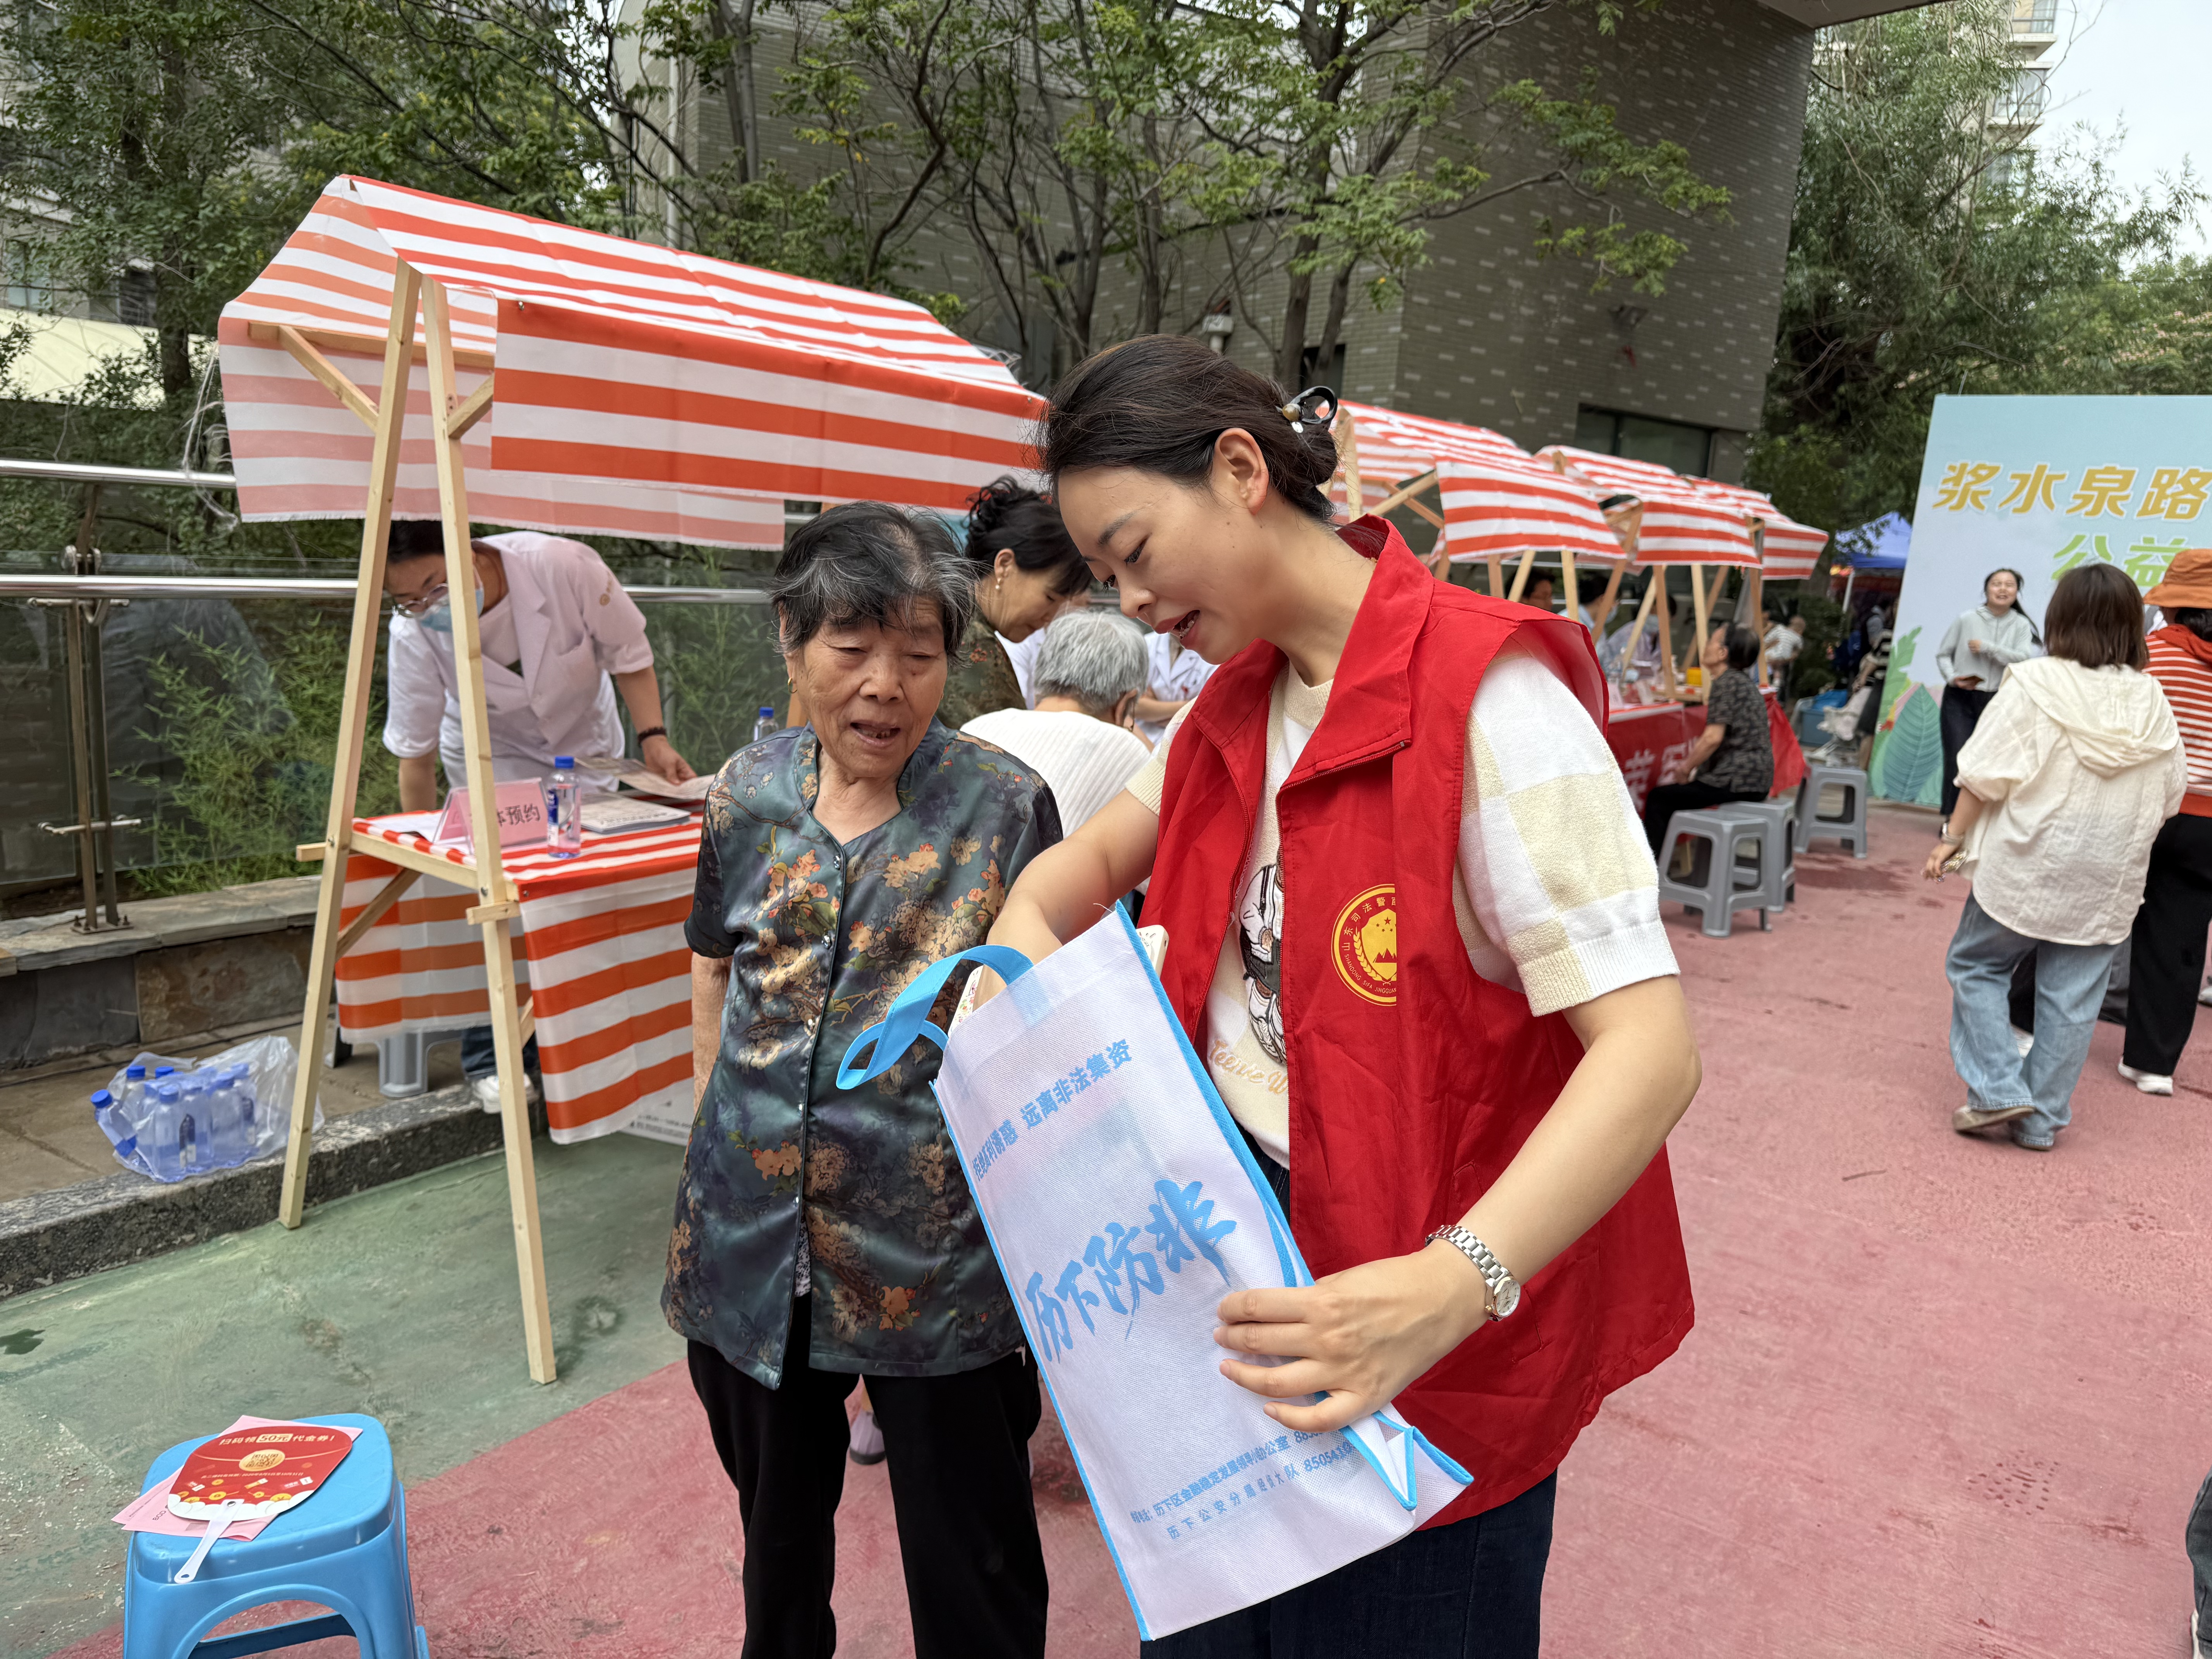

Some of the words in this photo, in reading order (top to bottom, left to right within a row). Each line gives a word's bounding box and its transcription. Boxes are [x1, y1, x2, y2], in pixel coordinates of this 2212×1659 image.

[1932, 462, 2212, 519] 浆水泉路
[2051, 535, 2191, 586] 公益
[1345, 954, 1361, 981] SHANDONG
[1362, 980, 1372, 989] SIFA
[1020, 1039, 1132, 1130] 远离非法集资
[1025, 1179, 1237, 1364] 历下防非
